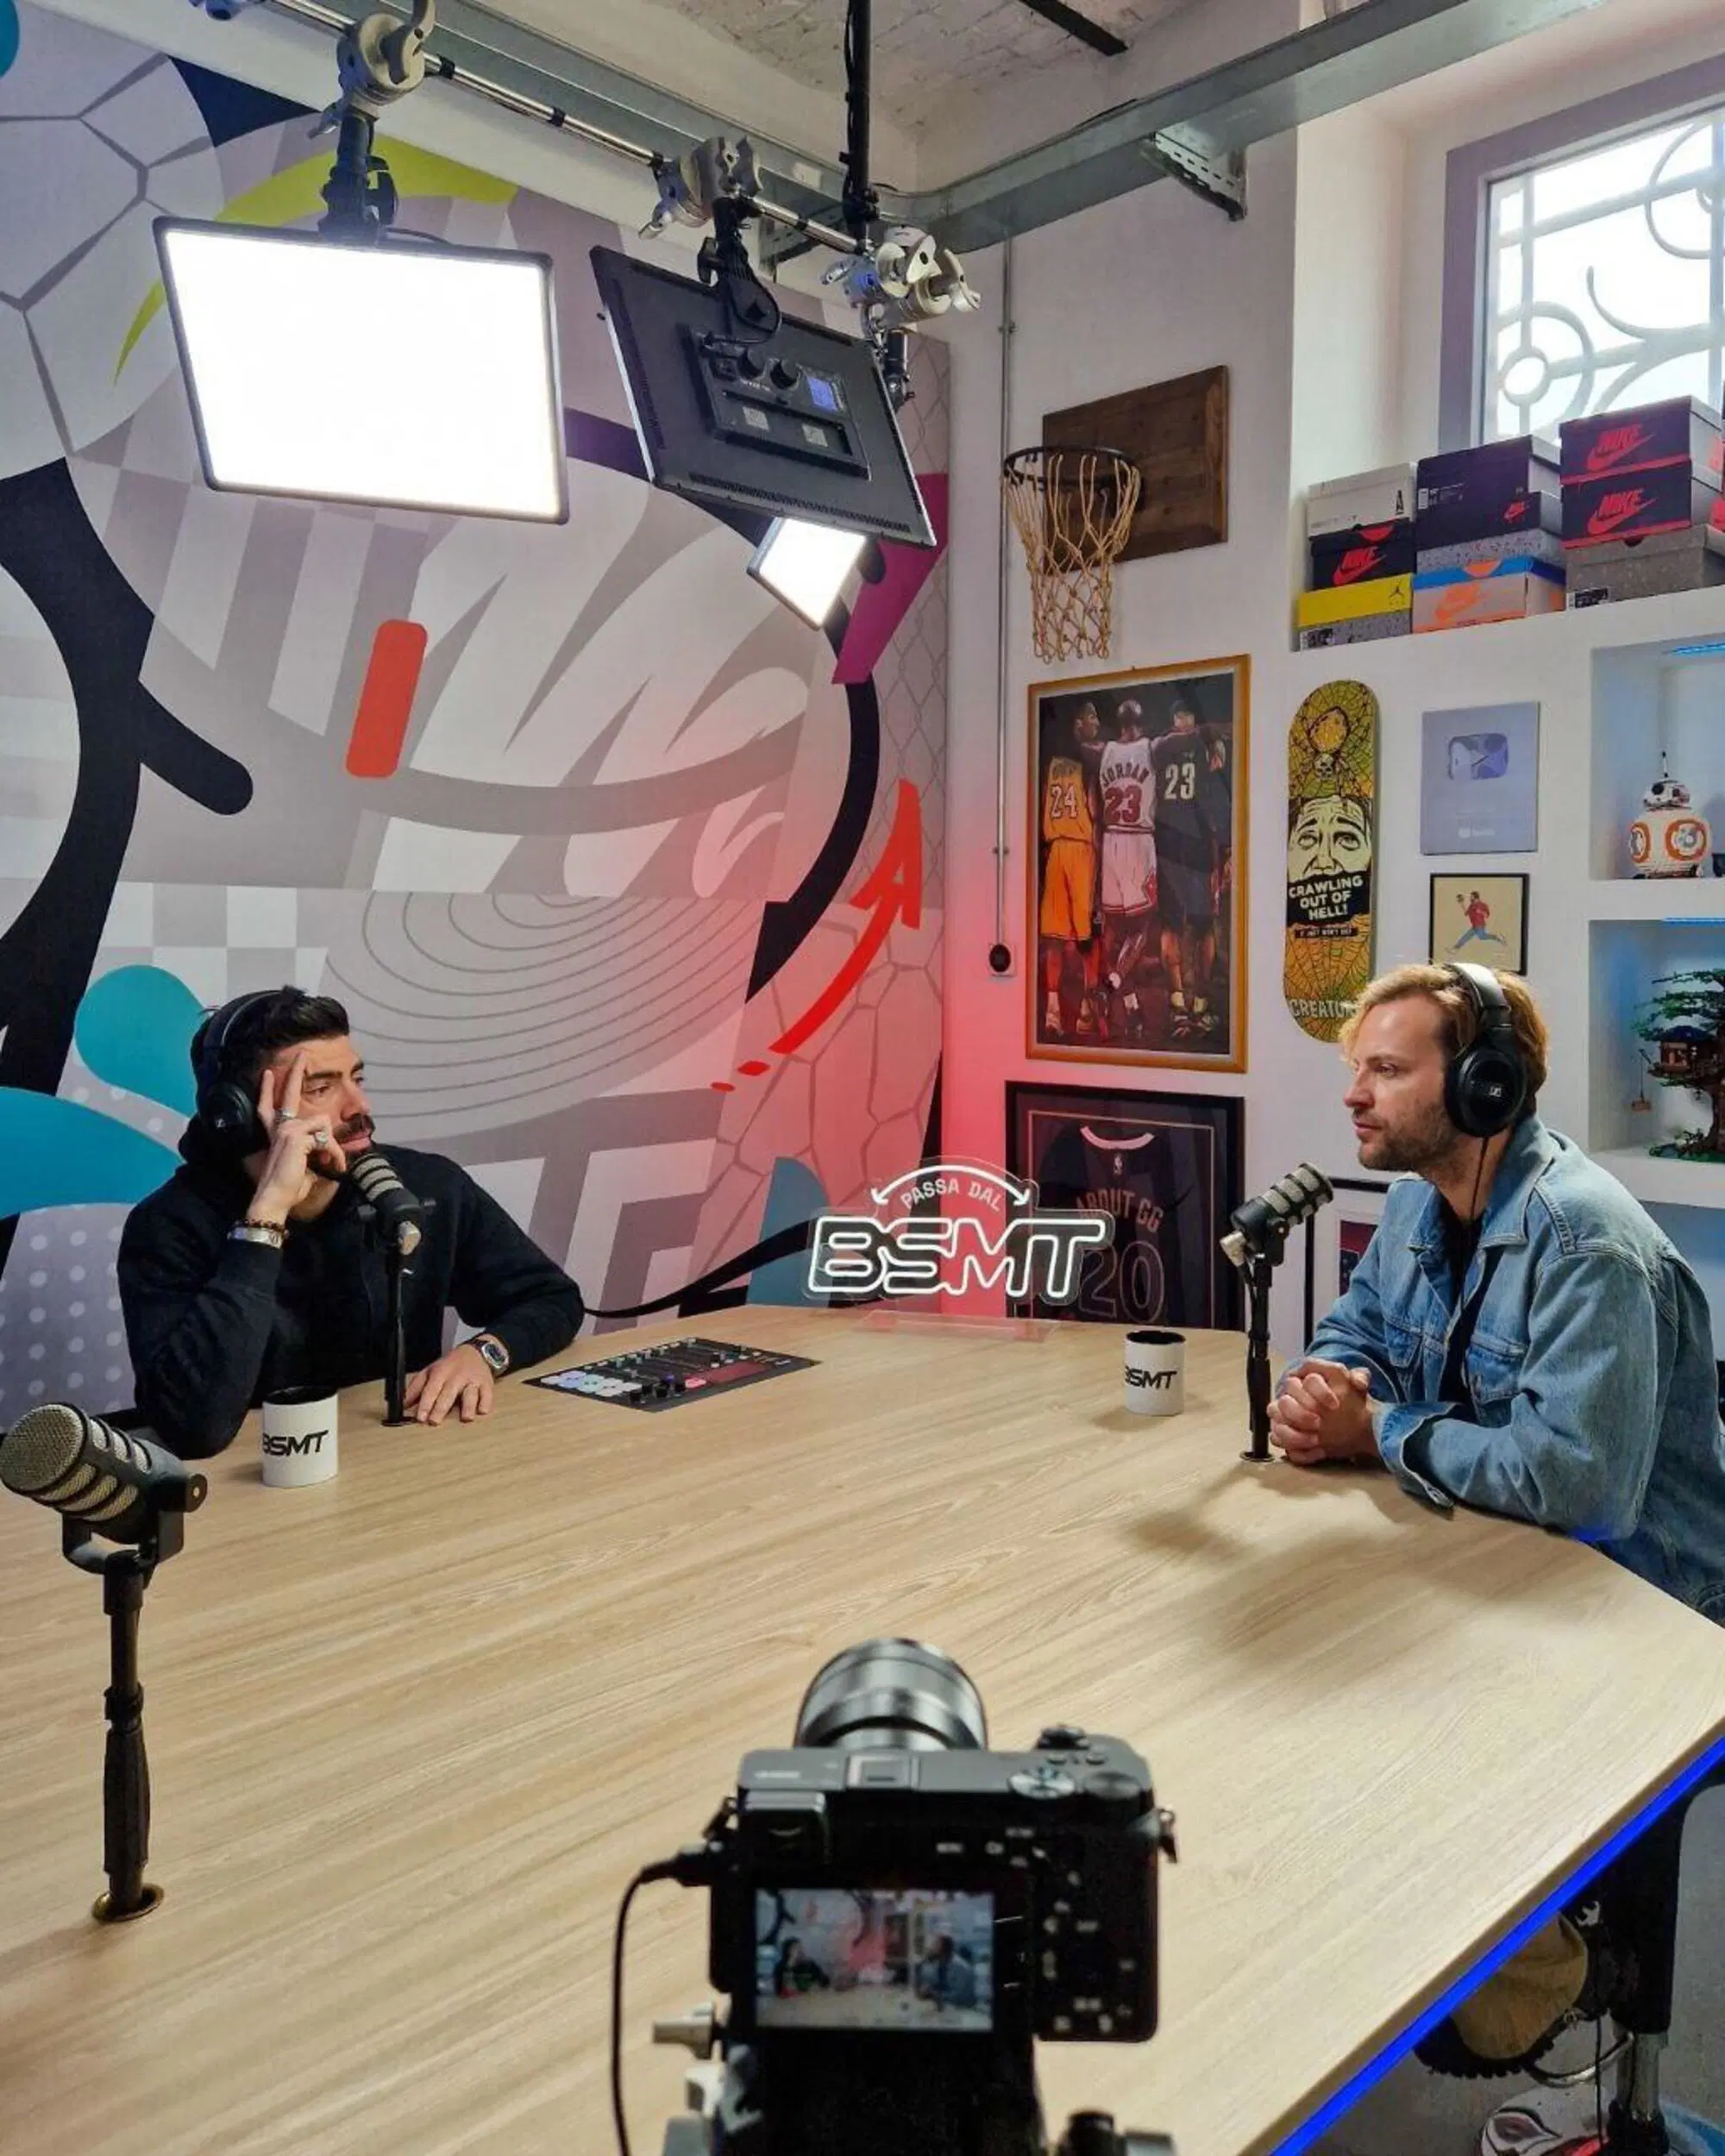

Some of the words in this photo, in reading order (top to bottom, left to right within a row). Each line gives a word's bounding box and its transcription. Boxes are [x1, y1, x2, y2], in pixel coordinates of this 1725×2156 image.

[1598, 424, 1642, 454] NIKE
[1599, 488, 1643, 517] NIKE
[1101, 761, 1151, 788] JORDAN
[1165, 762, 1195, 800] 23
[1051, 784, 1077, 819] 24
[1104, 785, 1143, 824] 23
[1289, 874, 1363, 898] CRAWLING
[1300, 893, 1327, 909] OUT
[1332, 890, 1352, 904] OF
[1308, 903, 1348, 920] HELL!
[900, 1178, 960, 1210] PASSA
[968, 1181, 1004, 1212] DAL
[808, 1216, 1106, 1298] BSMT
[1079, 1240, 1164, 1323] 20
